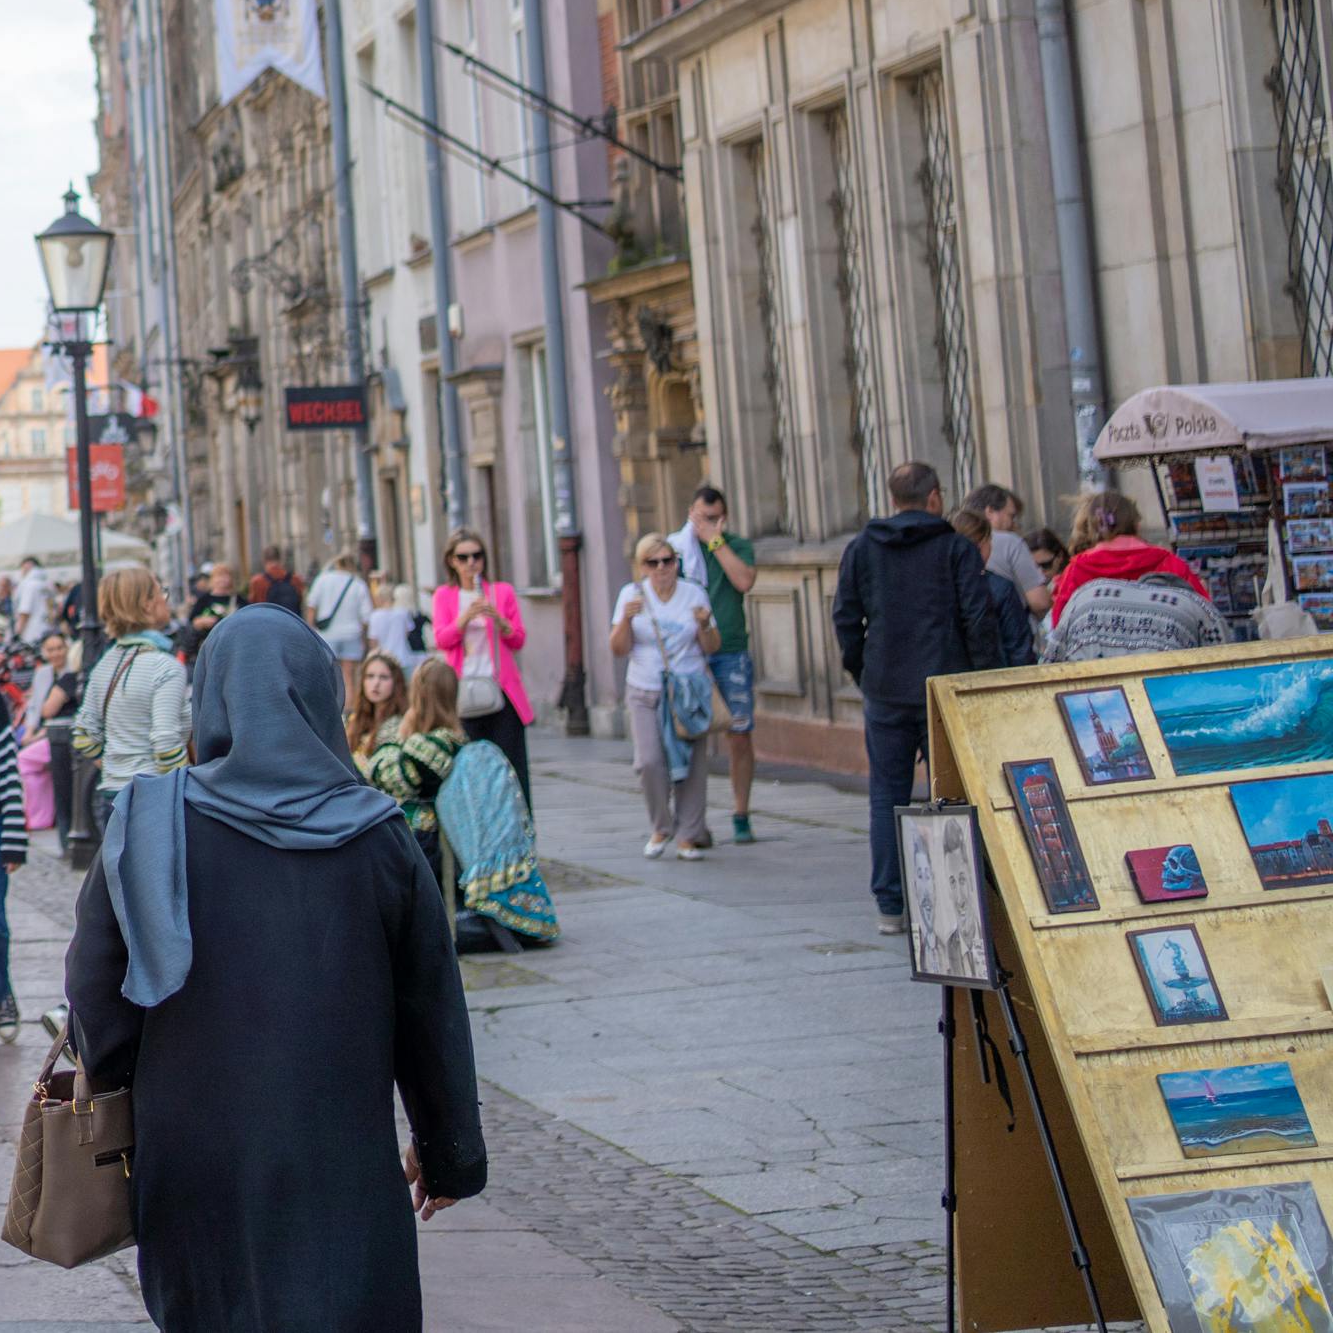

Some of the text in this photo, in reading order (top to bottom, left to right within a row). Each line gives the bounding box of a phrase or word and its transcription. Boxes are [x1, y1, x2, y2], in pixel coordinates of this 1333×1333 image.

[288, 399, 364, 424] WECHSEL
[1107, 412, 1217, 444] Poczta Polska
